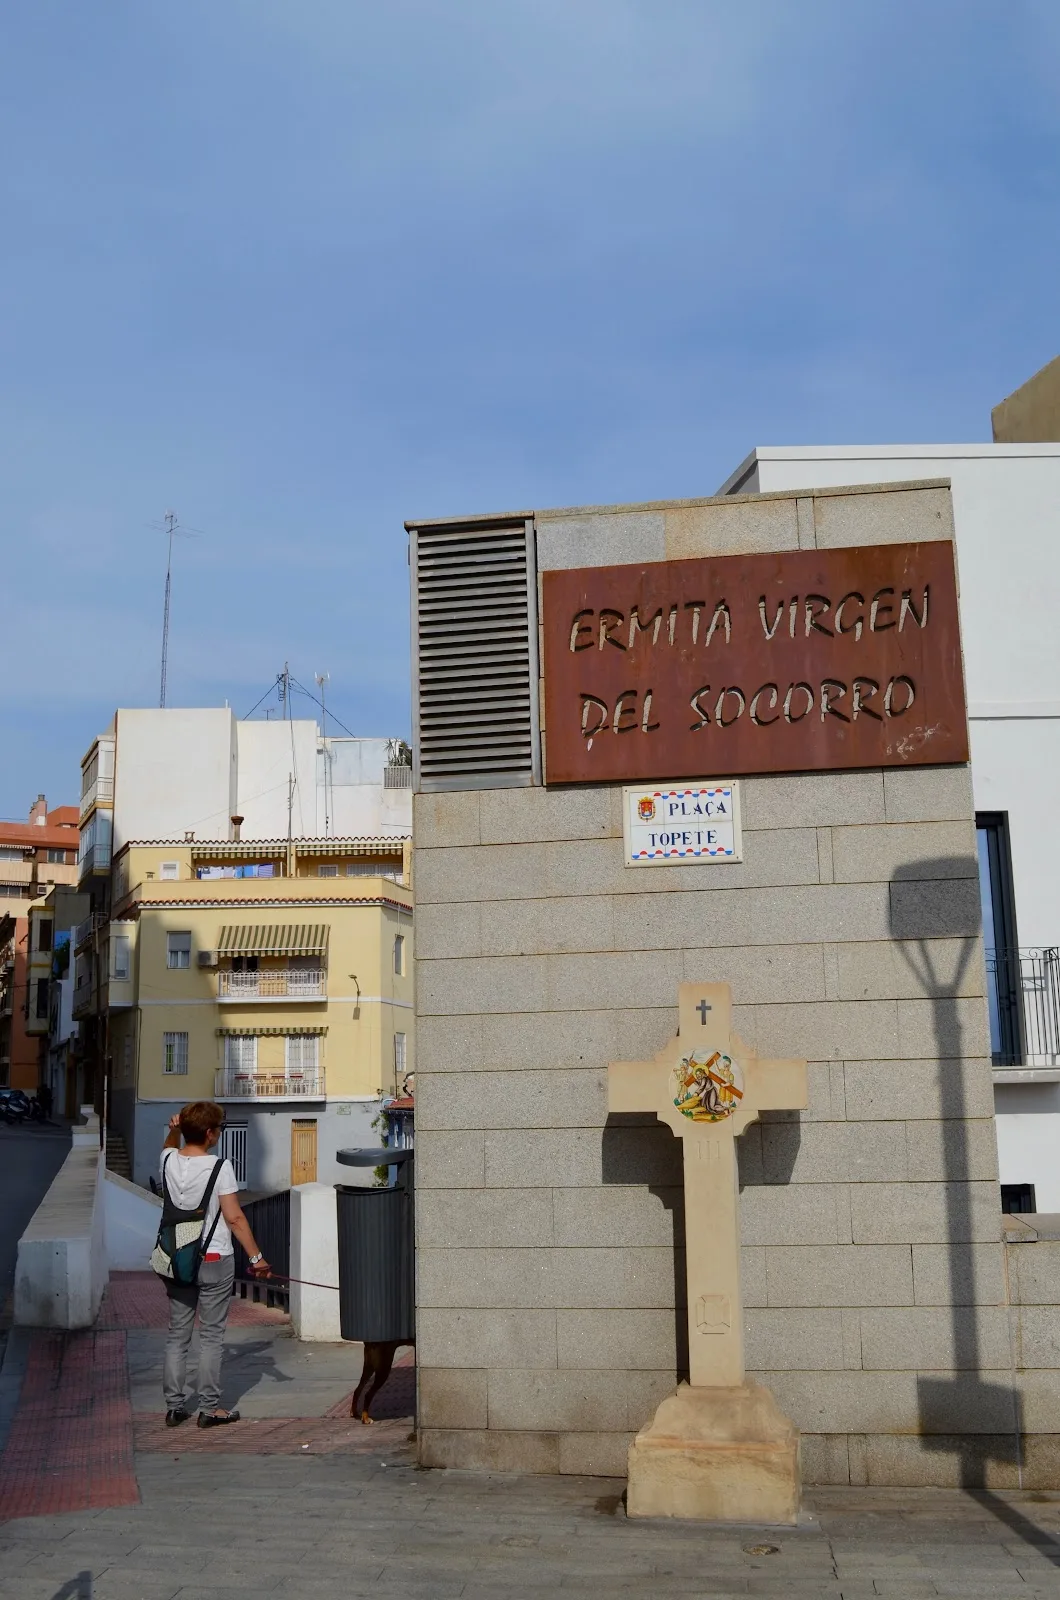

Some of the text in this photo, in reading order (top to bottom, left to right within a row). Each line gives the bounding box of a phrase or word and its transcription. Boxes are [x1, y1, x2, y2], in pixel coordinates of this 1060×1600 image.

[569, 584, 930, 653] ERMITA VIRGEN
[580, 675, 916, 738] DEL SOCORRO
[668, 801, 728, 817] PLAÇA
[648, 829, 718, 847] TOPETE
